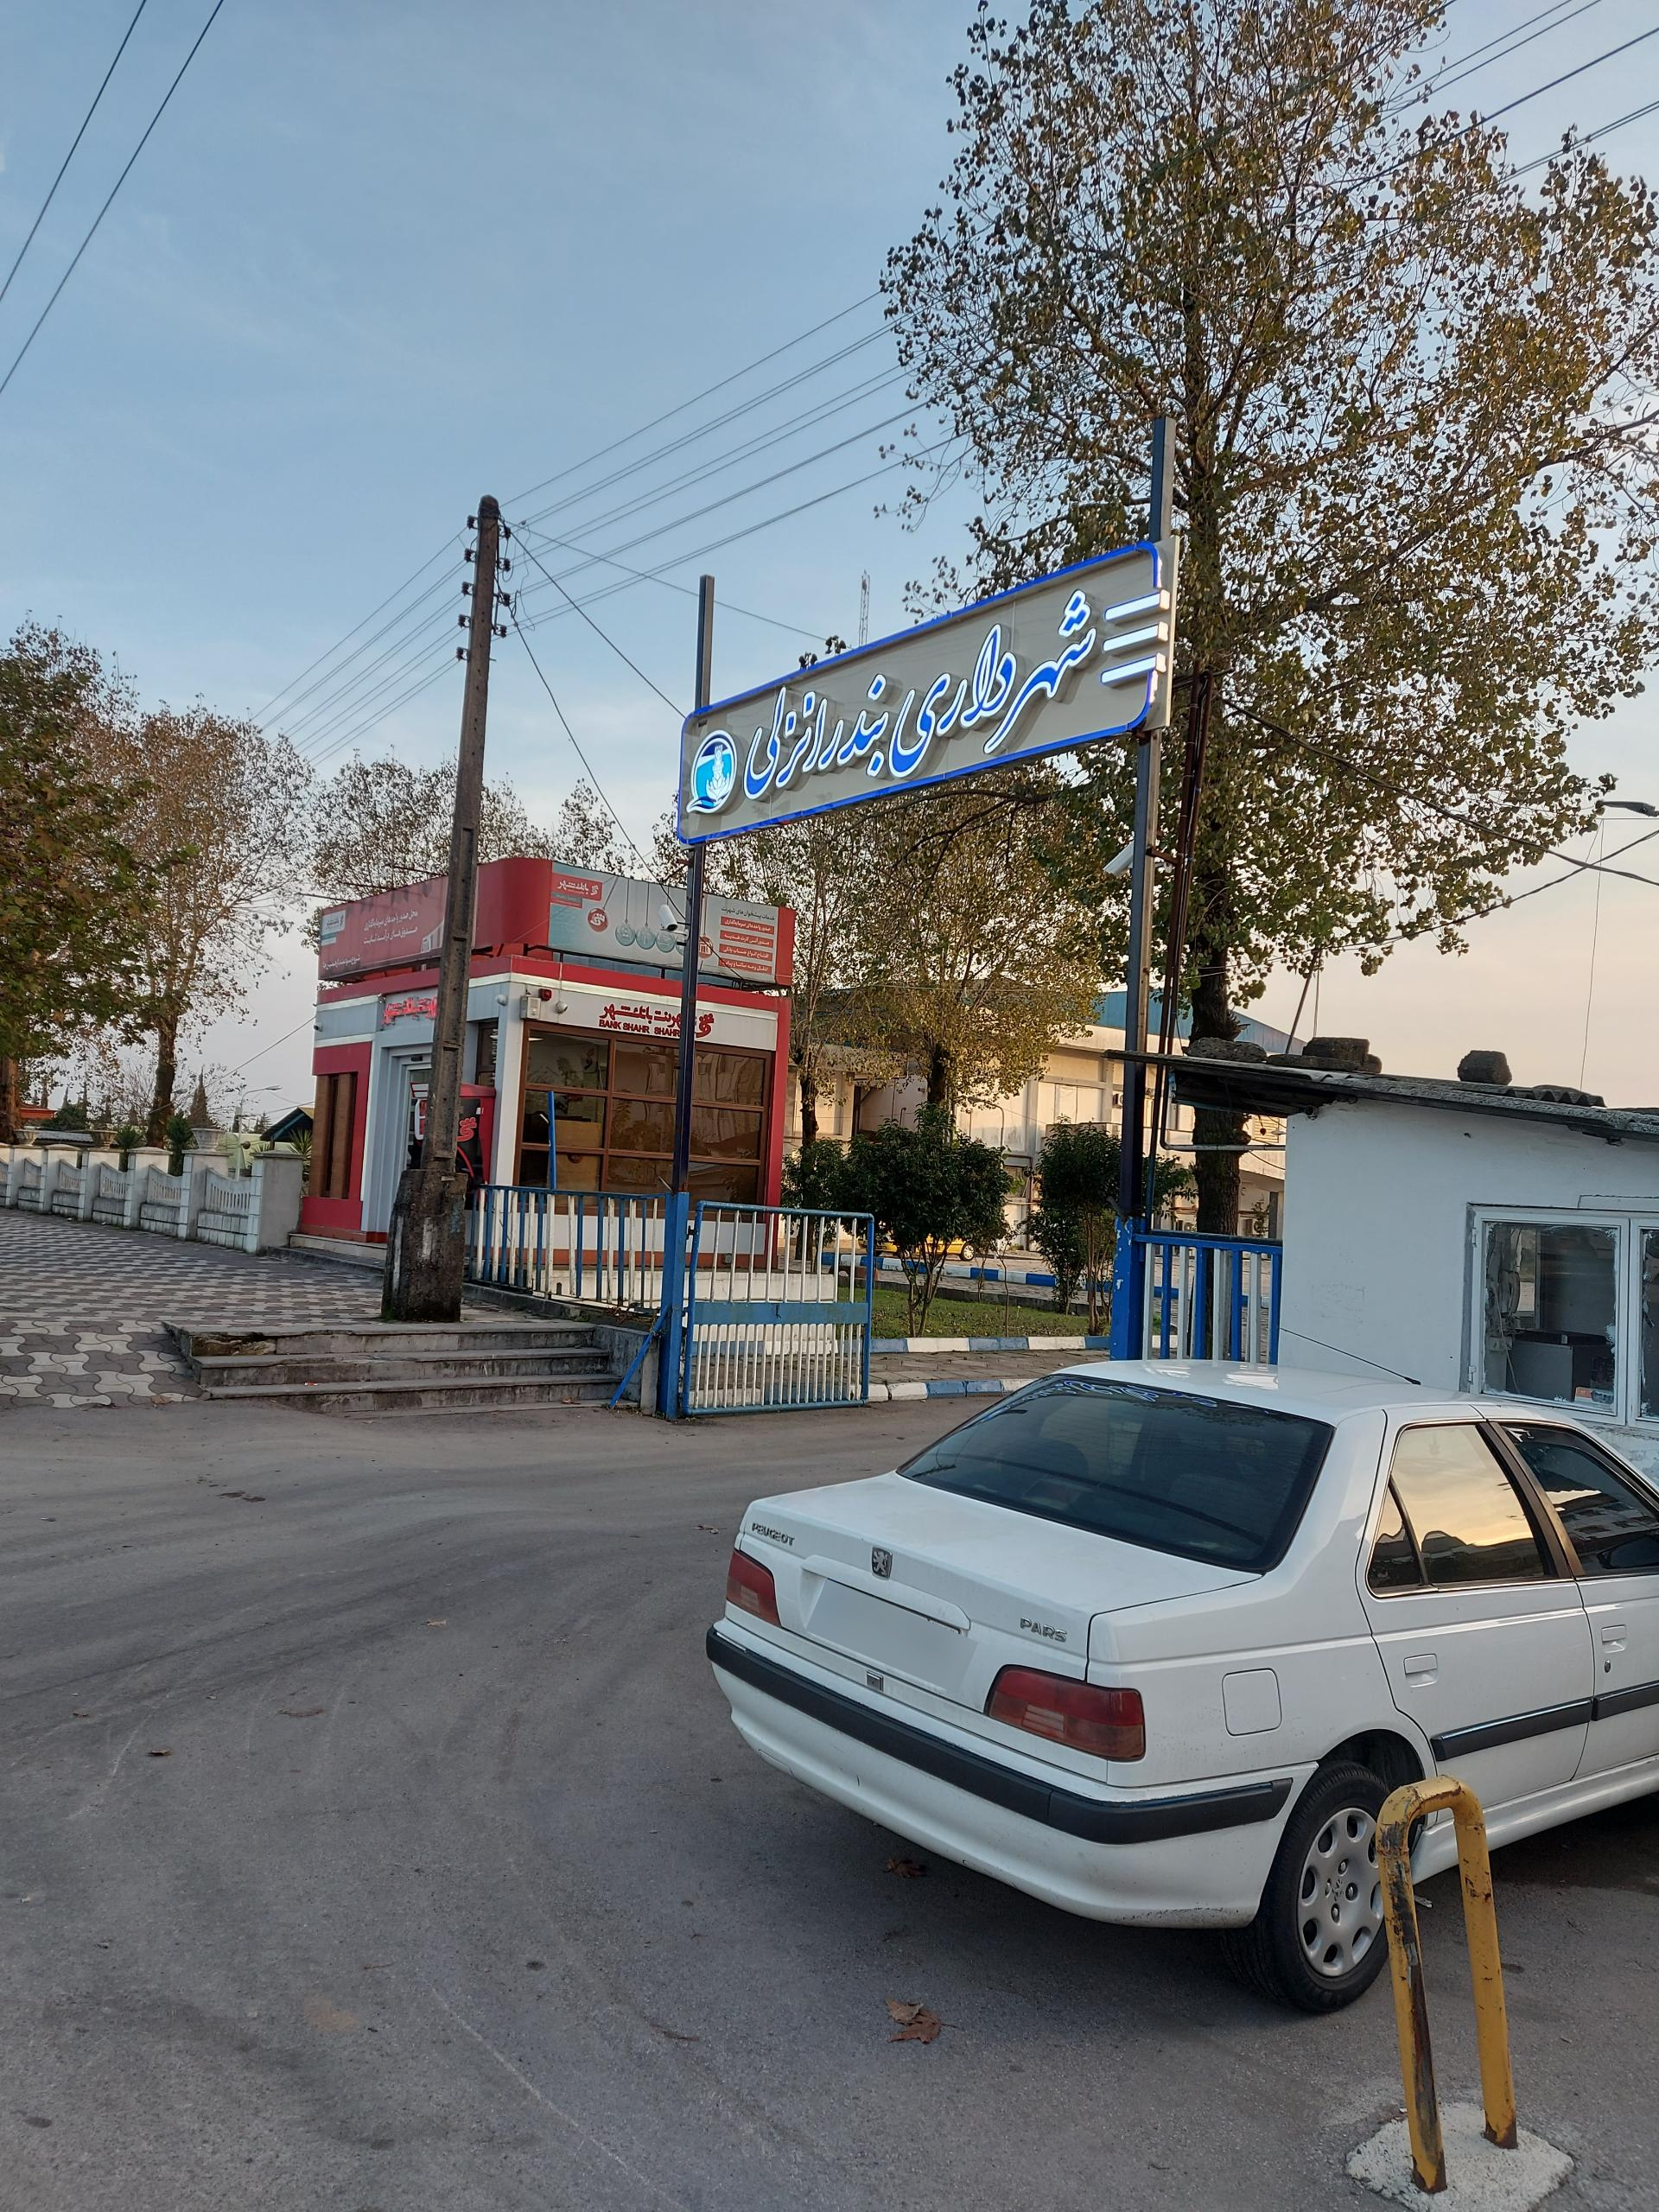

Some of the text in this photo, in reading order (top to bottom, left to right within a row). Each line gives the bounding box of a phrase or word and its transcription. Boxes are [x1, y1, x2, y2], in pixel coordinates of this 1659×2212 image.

[743, 589, 1097, 800] شهرداری بندر انزلی
[599, 1019, 621, 1030] BANK
[622, 1022, 650, 1034] SHAHR
[752, 1522, 795, 1547] PEUGEOT
[1020, 1617, 1067, 1643] PARS
